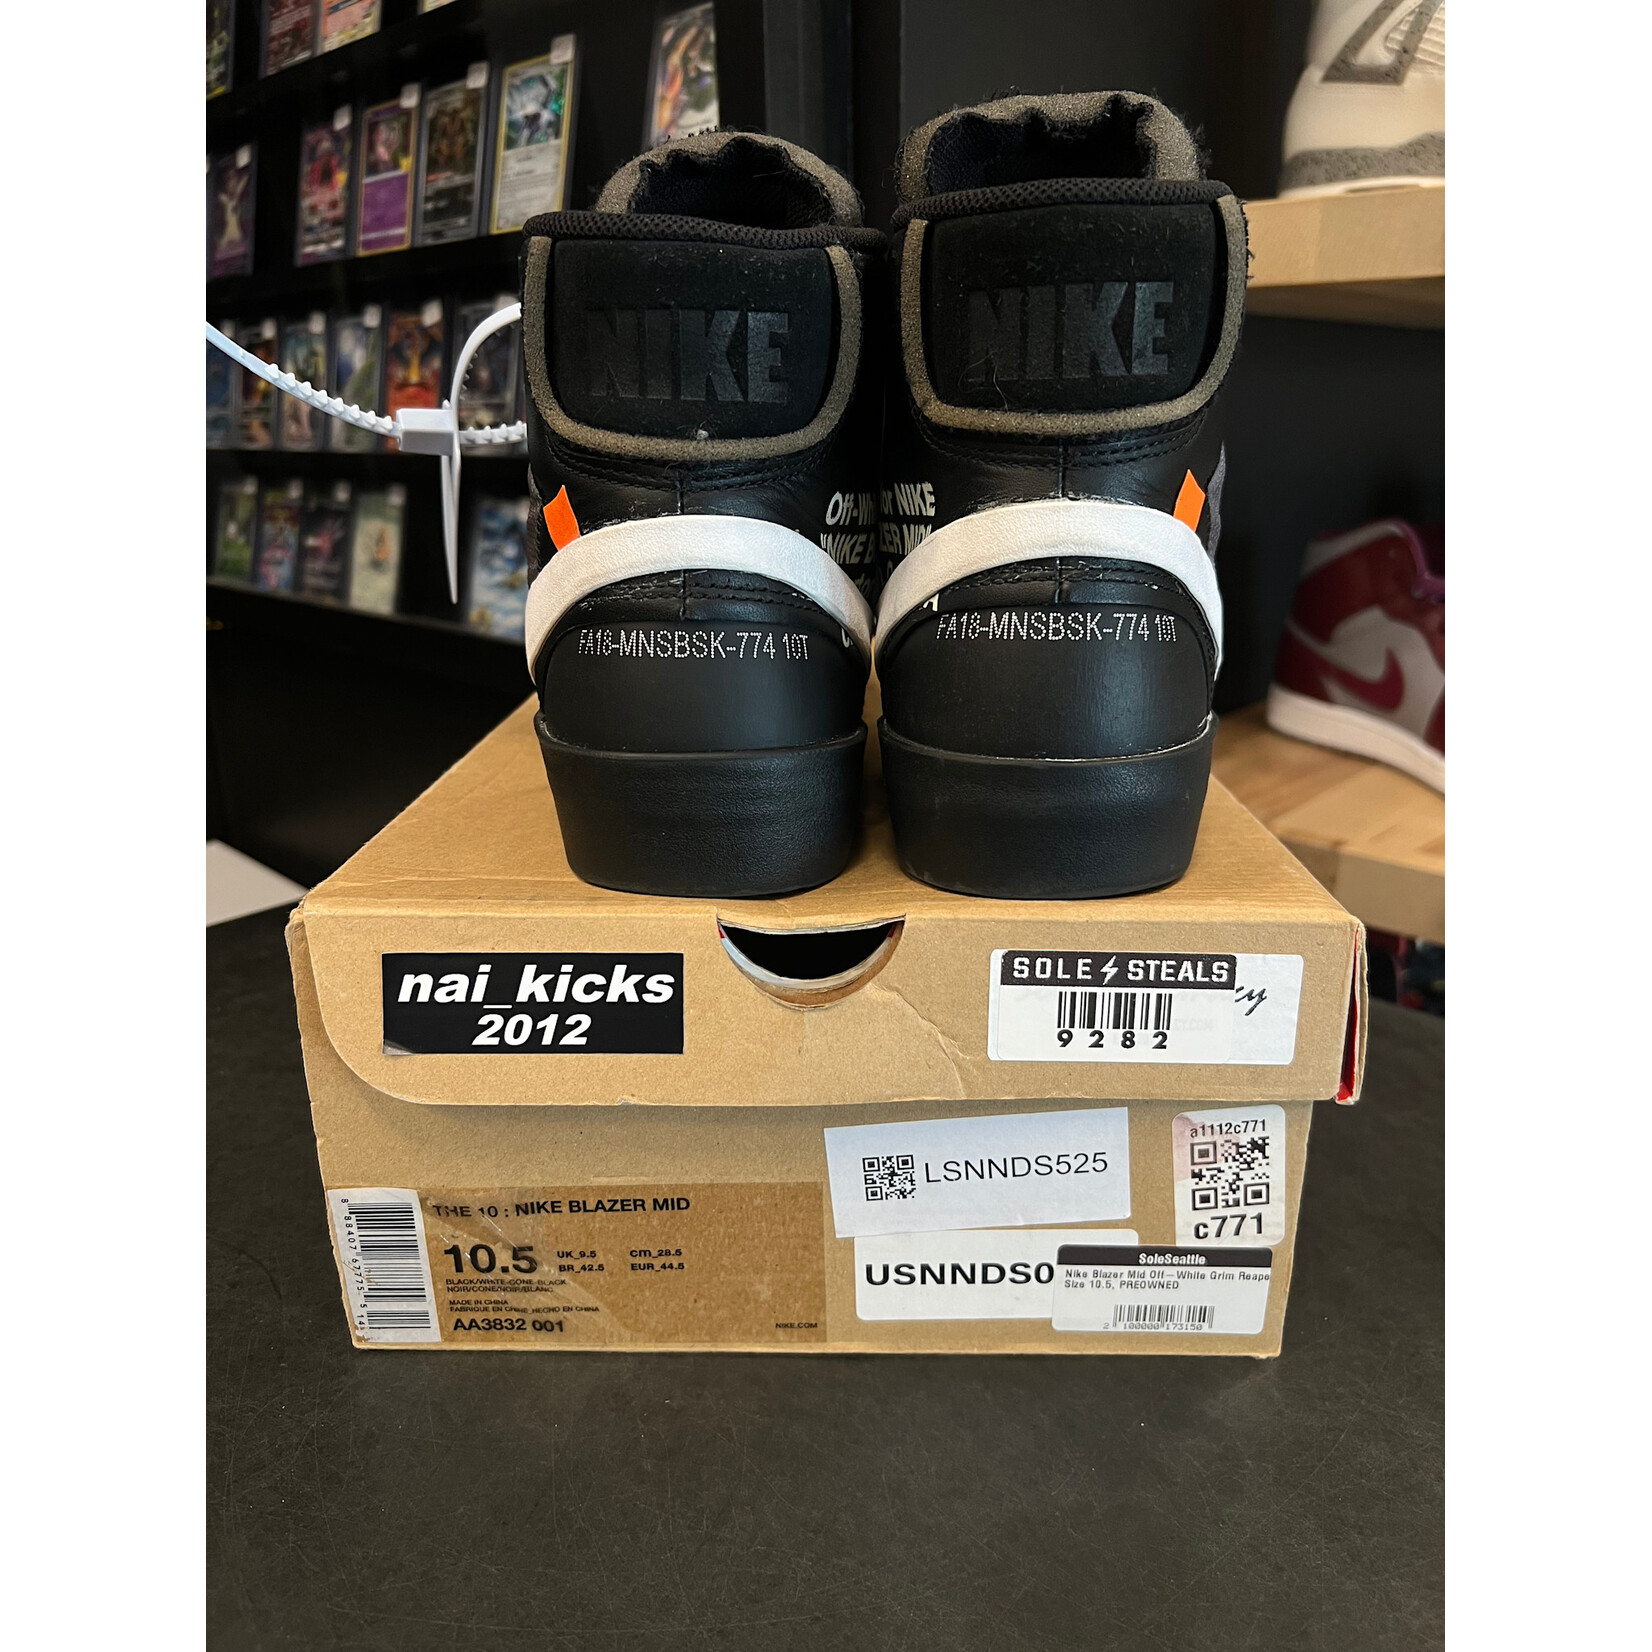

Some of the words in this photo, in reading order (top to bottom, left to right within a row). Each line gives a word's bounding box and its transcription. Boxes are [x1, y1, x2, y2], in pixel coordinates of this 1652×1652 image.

[967, 281, 1174, 382] NIKE
[588, 309, 792, 402] NIKE
[894, 481, 936, 517] NIKE
[936, 611, 1150, 642] FA18-MNSBSK-774
[578, 629, 776, 660] FA18-MNSBSK-774
[782, 632, 808, 660] 10T
[1012, 956, 1092, 980] SOLE
[1127, 959, 1229, 982] STEALS
[398, 964, 675, 1009] nai_kicks
[472, 1014, 592, 1046] 2012
[1190, 1119, 1266, 1138] a1112c771
[924, 1151, 1109, 1184] LSNNDS525
[432, 1204, 472, 1217] THE
[478, 1206, 498, 1218] 10
[515, 1200, 563, 1216] NIKE
[568, 1198, 647, 1214] BLAZER
[652, 1197, 691, 1212] MID
[1193, 1212, 1262, 1240] c771
[444, 1243, 538, 1274] 10.5
[556, 1250, 597, 1259] UK_9.5
[630, 1262, 685, 1273] EUR_44.5
[1138, 1253, 1206, 1266] SoleSeattle
[558, 1263, 605, 1274] BR_42.5
[1065, 1269, 1088, 1279] Nike
[1092, 1269, 1123, 1280] Blazer
[1127, 1270, 1146, 1280] Mid
[1209, 1271, 1235, 1281] Grim
[1064, 1280, 1085, 1290] Size
[1119, 1281, 1179, 1290] PREOWNED
[453, 1318, 527, 1332] AA3832
[531, 1320, 565, 1333] 001
